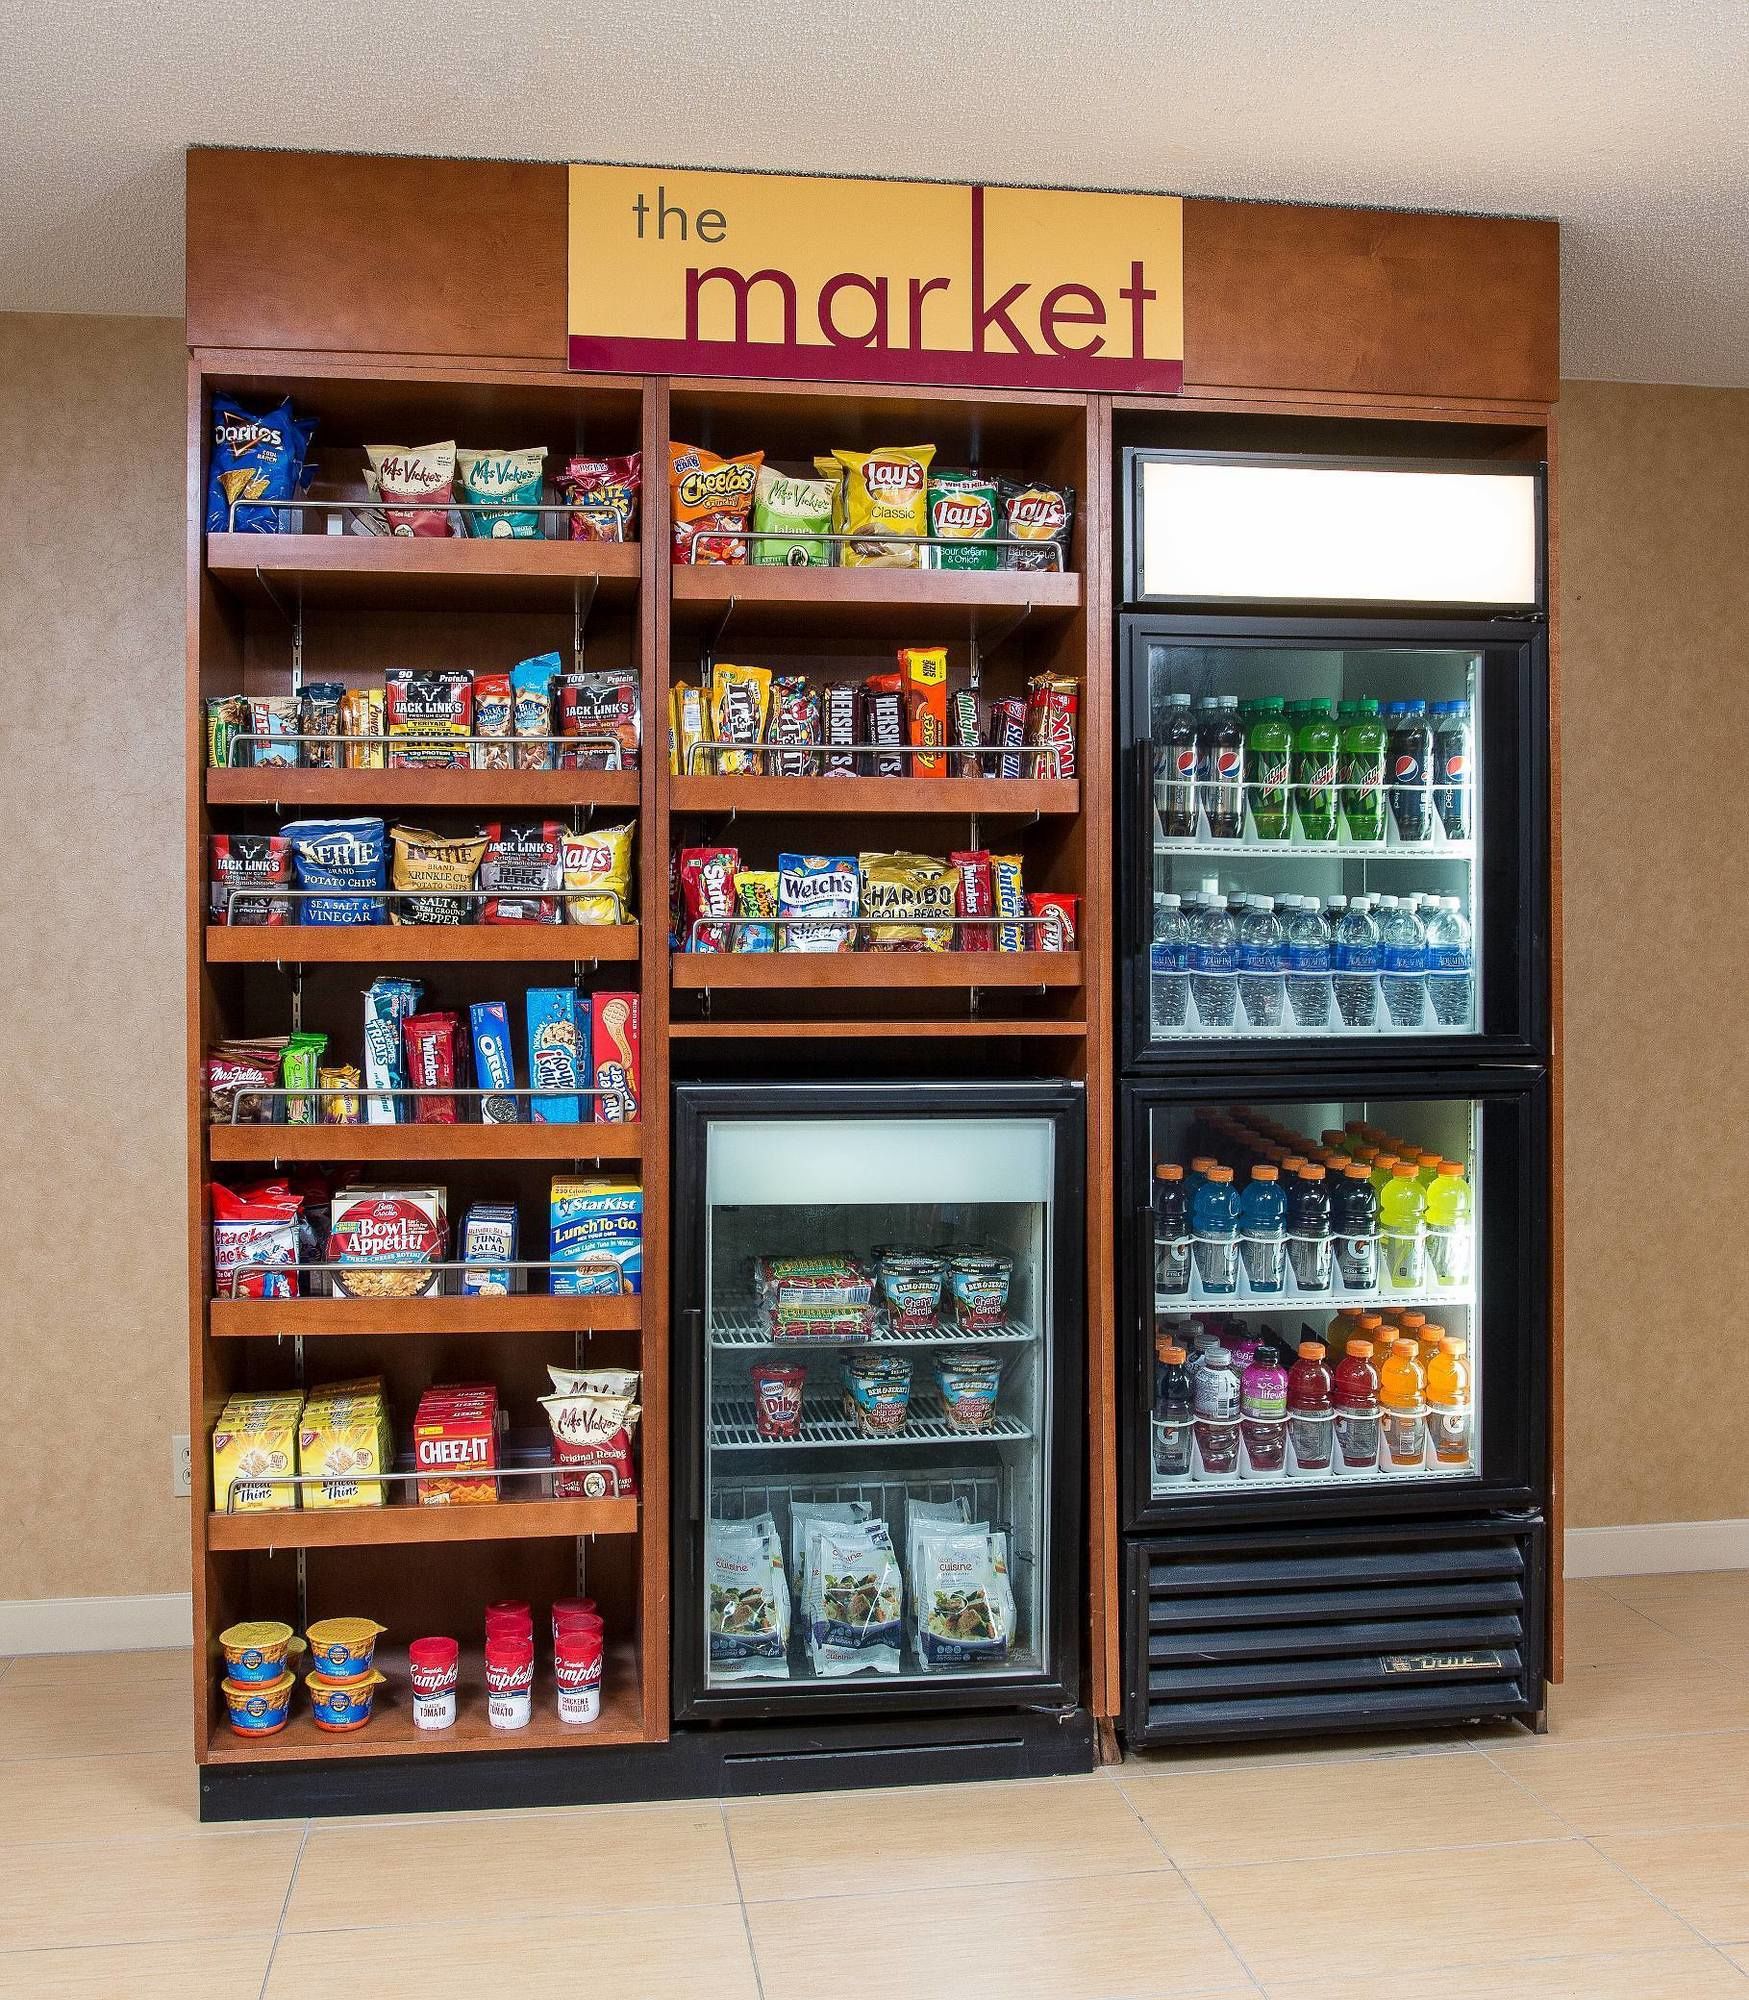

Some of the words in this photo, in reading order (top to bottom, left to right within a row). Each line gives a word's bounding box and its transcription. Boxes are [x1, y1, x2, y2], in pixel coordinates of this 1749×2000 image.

[632, 186, 727, 243] the
[685, 186, 1158, 358] market
[215, 424, 283, 445] Doritos
[404, 459, 442, 486] Vickie's
[496, 460, 535, 484] Vickie's
[868, 463, 921, 490] Lay's
[681, 466, 756, 507] Cheetos
[871, 506, 915, 519] Classic
[940, 502, 989, 528] Lay's
[1009, 499, 1062, 527] Lay's
[922, 659, 930, 677] KING
[929, 659, 937, 677] SIZE
[398, 671, 413, 679] 90
[439, 674, 468, 682] Protein
[607, 675, 634, 684] Protein
[395, 702, 422, 713] JACK
[425, 701, 463, 714] LINK'S
[565, 706, 592, 717] JACK
[592, 702, 629, 716] LINK'S
[298, 838, 380, 866] KETTLE
[488, 842, 516, 853] JACK
[517, 841, 554, 853] LINK'S
[217, 860, 243, 871] JACK
[244, 860, 280, 871] LINK'S
[327, 867, 355, 875] BRAND
[427, 863, 455, 871] BRAND
[499, 867, 542, 876] BEEF
[304, 875, 345, 886] POTATO
[347, 878, 377, 887] CHIPS
[494, 875, 546, 885] JERKY
[784, 876, 853, 898] Welch's
[871, 885, 951, 906] HARIBO
[311, 900, 331, 908] SEA
[332, 901, 360, 910] SALT
[362, 902, 369, 910] &
[420, 897, 451, 908] SALT
[451, 901, 459, 909] &
[309, 910, 371, 922] VINEGAR
[416, 911, 460, 925] PEPPER
[364, 1019, 388, 1066] TREATS
[571, 1197, 636, 1211] StarKist
[373, 1209, 398, 1219] Crocker
[360, 1218, 407, 1237] Bowl
[555, 1219, 598, 1243] Lunch
[474, 1235, 504, 1245] TUNA
[471, 1244, 505, 1254] SALAD
[904, 1297, 933, 1308] Cherry
[974, 1295, 1002, 1307] Cherry
[905, 1306, 932, 1315] Garcia
[976, 1305, 1001, 1315] Garcia
[766, 1397, 800, 1414] Dibs
[419, 1437, 488, 1465] CHEEZ-IT
[560, 1451, 594, 1463] Original
[595, 1449, 627, 1460] Recipe
[235, 1484, 272, 1502] Thins
[321, 1484, 359, 1500] Thins
[716, 1559, 749, 1572] cuisine
[939, 1562, 973, 1572] cuisine
[420, 1706, 446, 1717] TOMATO
[489, 1707, 513, 1717] TOMATO
